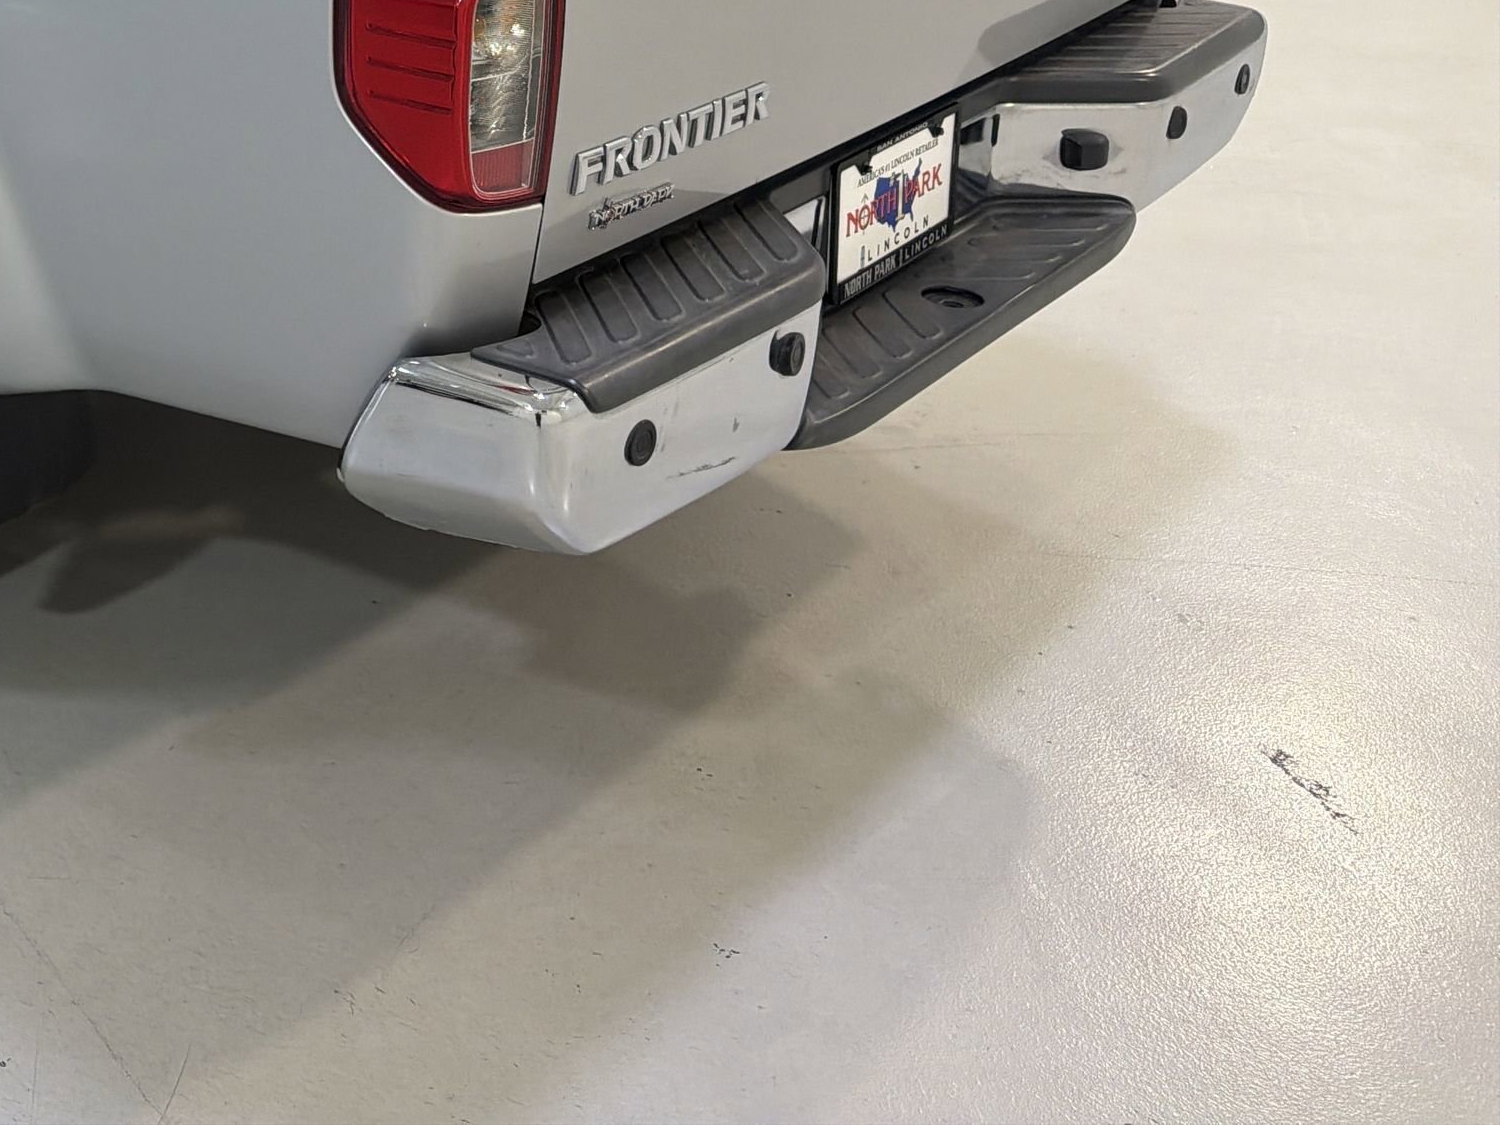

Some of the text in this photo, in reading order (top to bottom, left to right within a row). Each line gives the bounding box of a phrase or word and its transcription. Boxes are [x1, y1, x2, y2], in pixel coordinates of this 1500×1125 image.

[570, 81, 771, 196] FRONTIER
[876, 139, 893, 153] SAN
[891, 151, 915, 169] LINCOLN
[915, 138, 939, 156] RETAILER
[846, 162, 943, 237] NORTH PARK
[844, 224, 948, 299] NORTH PARK LINCOLN
[867, 215, 929, 262] LINCOLN
